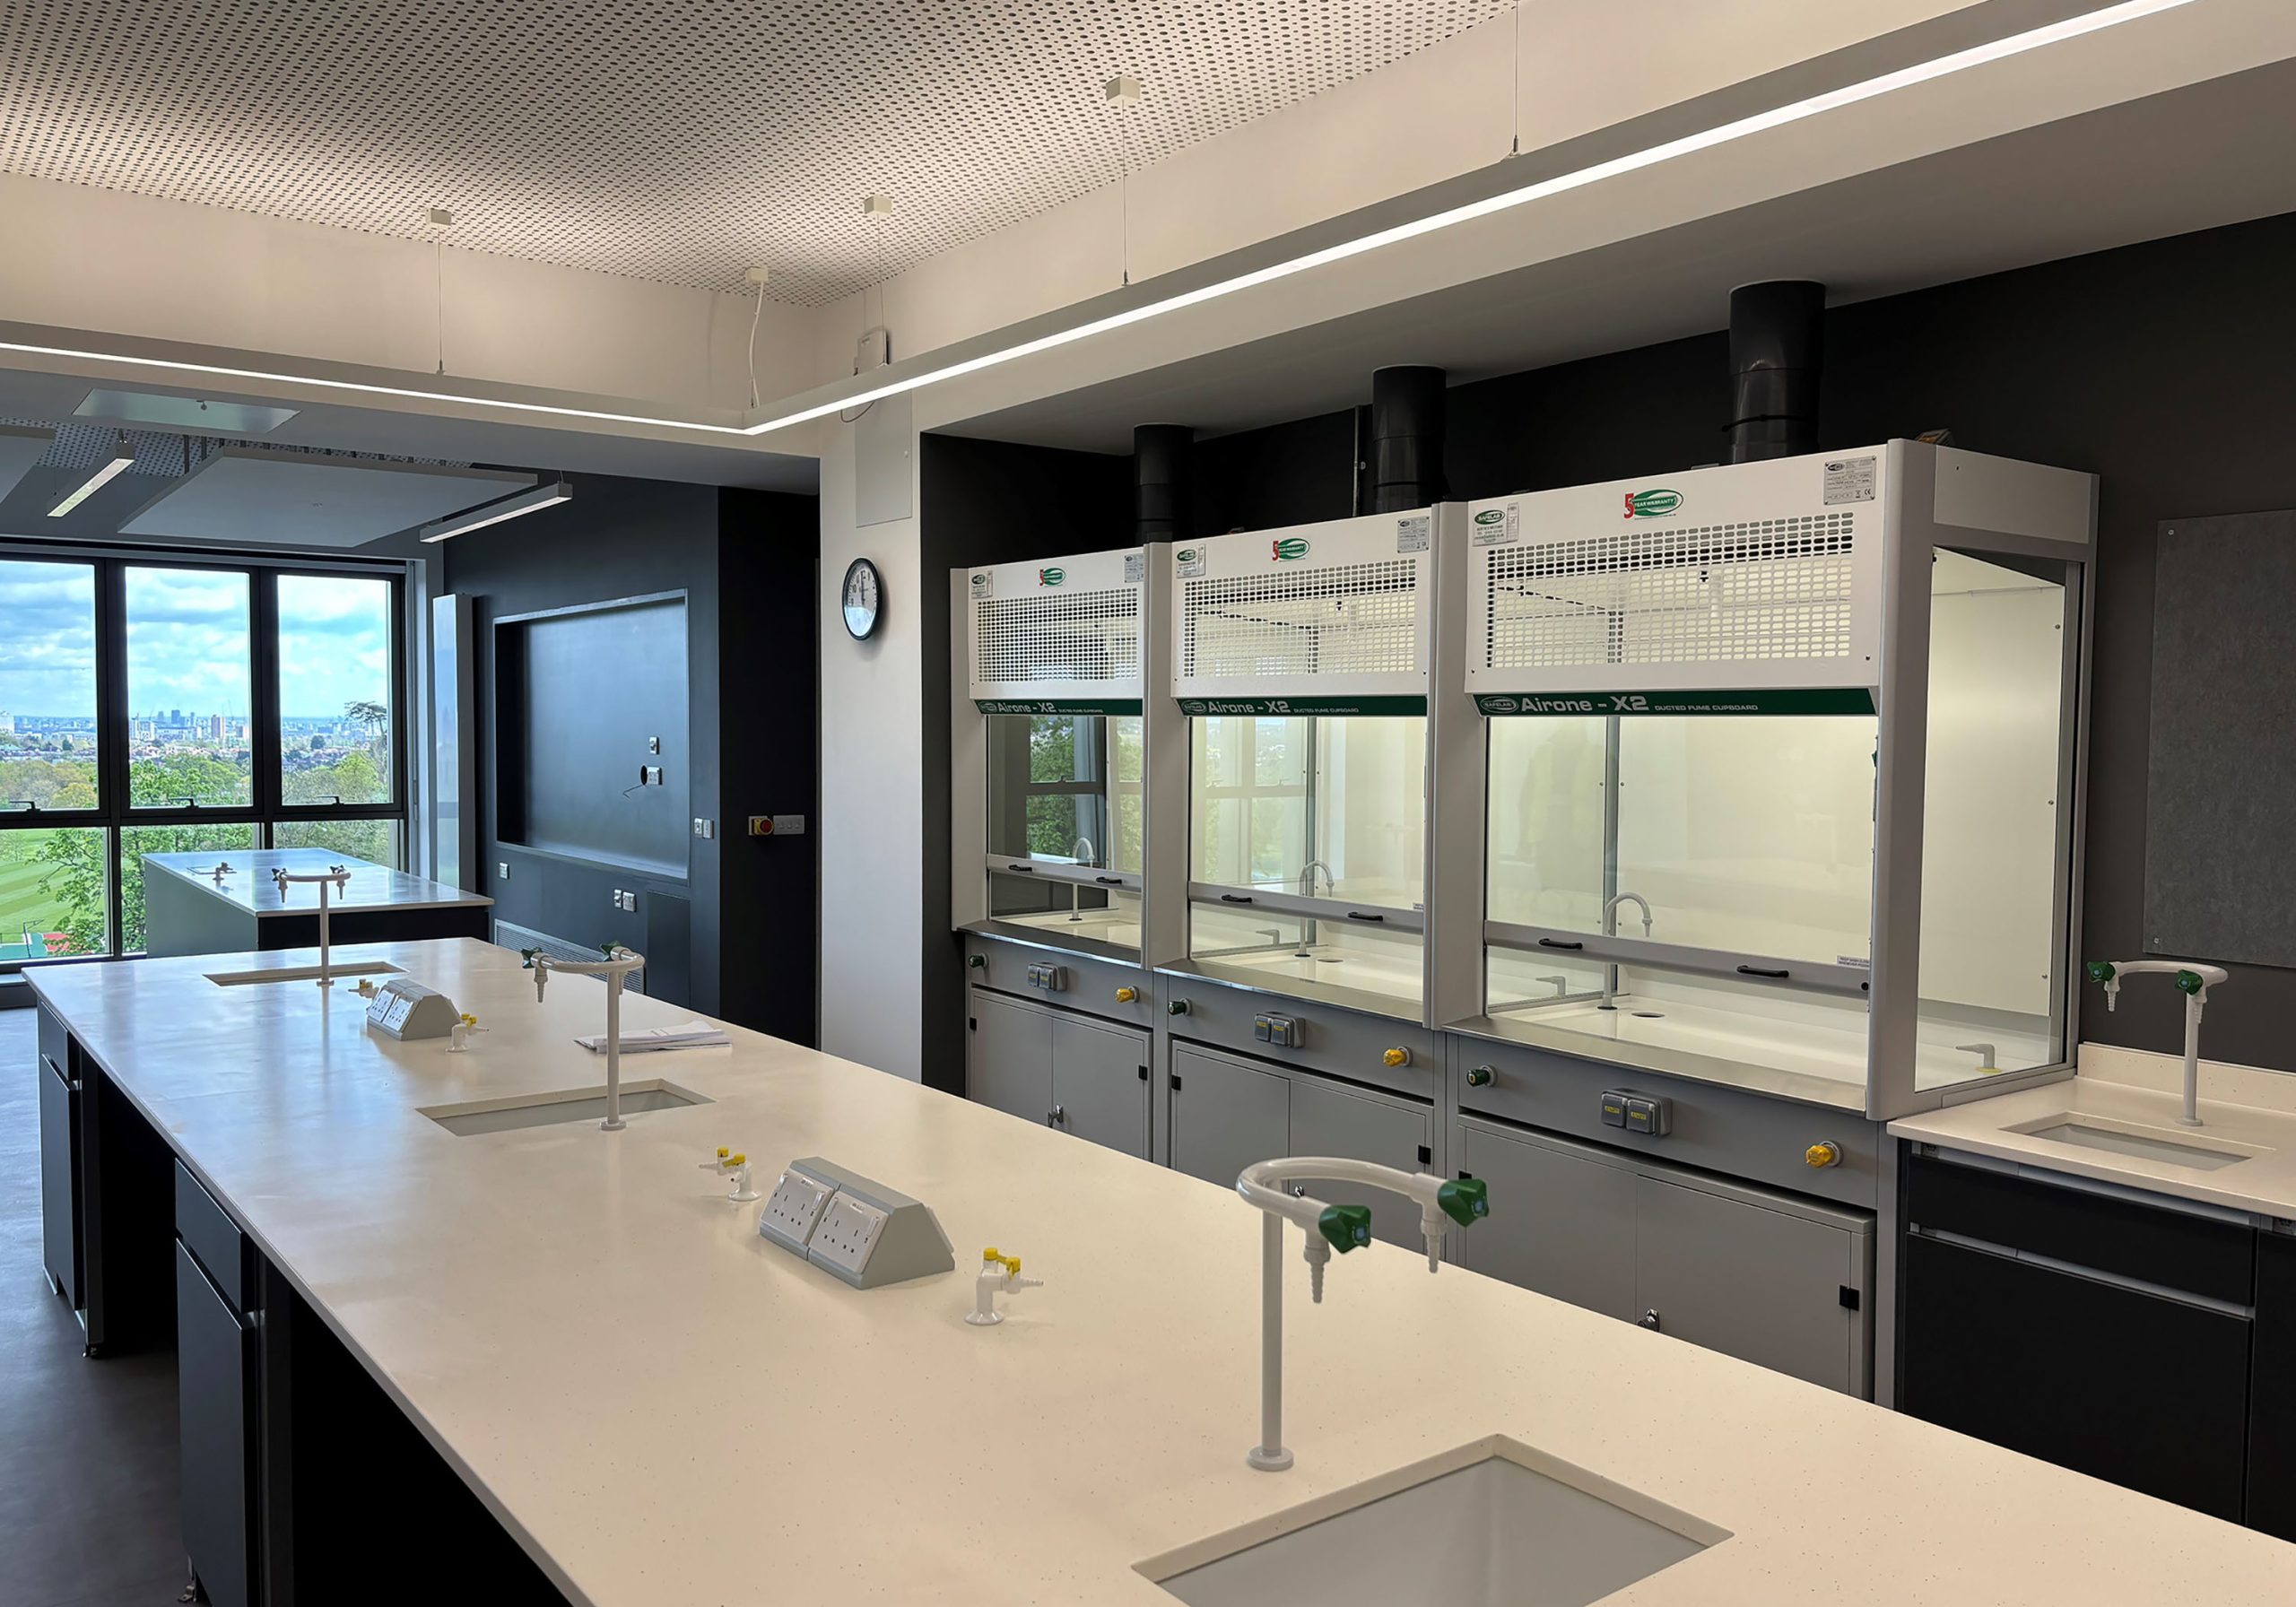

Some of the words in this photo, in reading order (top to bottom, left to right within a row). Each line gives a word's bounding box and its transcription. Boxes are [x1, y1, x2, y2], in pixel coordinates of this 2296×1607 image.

[1623, 492, 1635, 519] 5
[1647, 498, 1674, 507] WARRANTY
[996, 702, 1031, 713] Airone
[1037, 702, 1057, 713] X2
[1208, 700, 1255, 714] Airone
[1265, 700, 1292, 714] X2
[1521, 698, 1593, 712] Airone
[1610, 695, 1650, 711] X2
